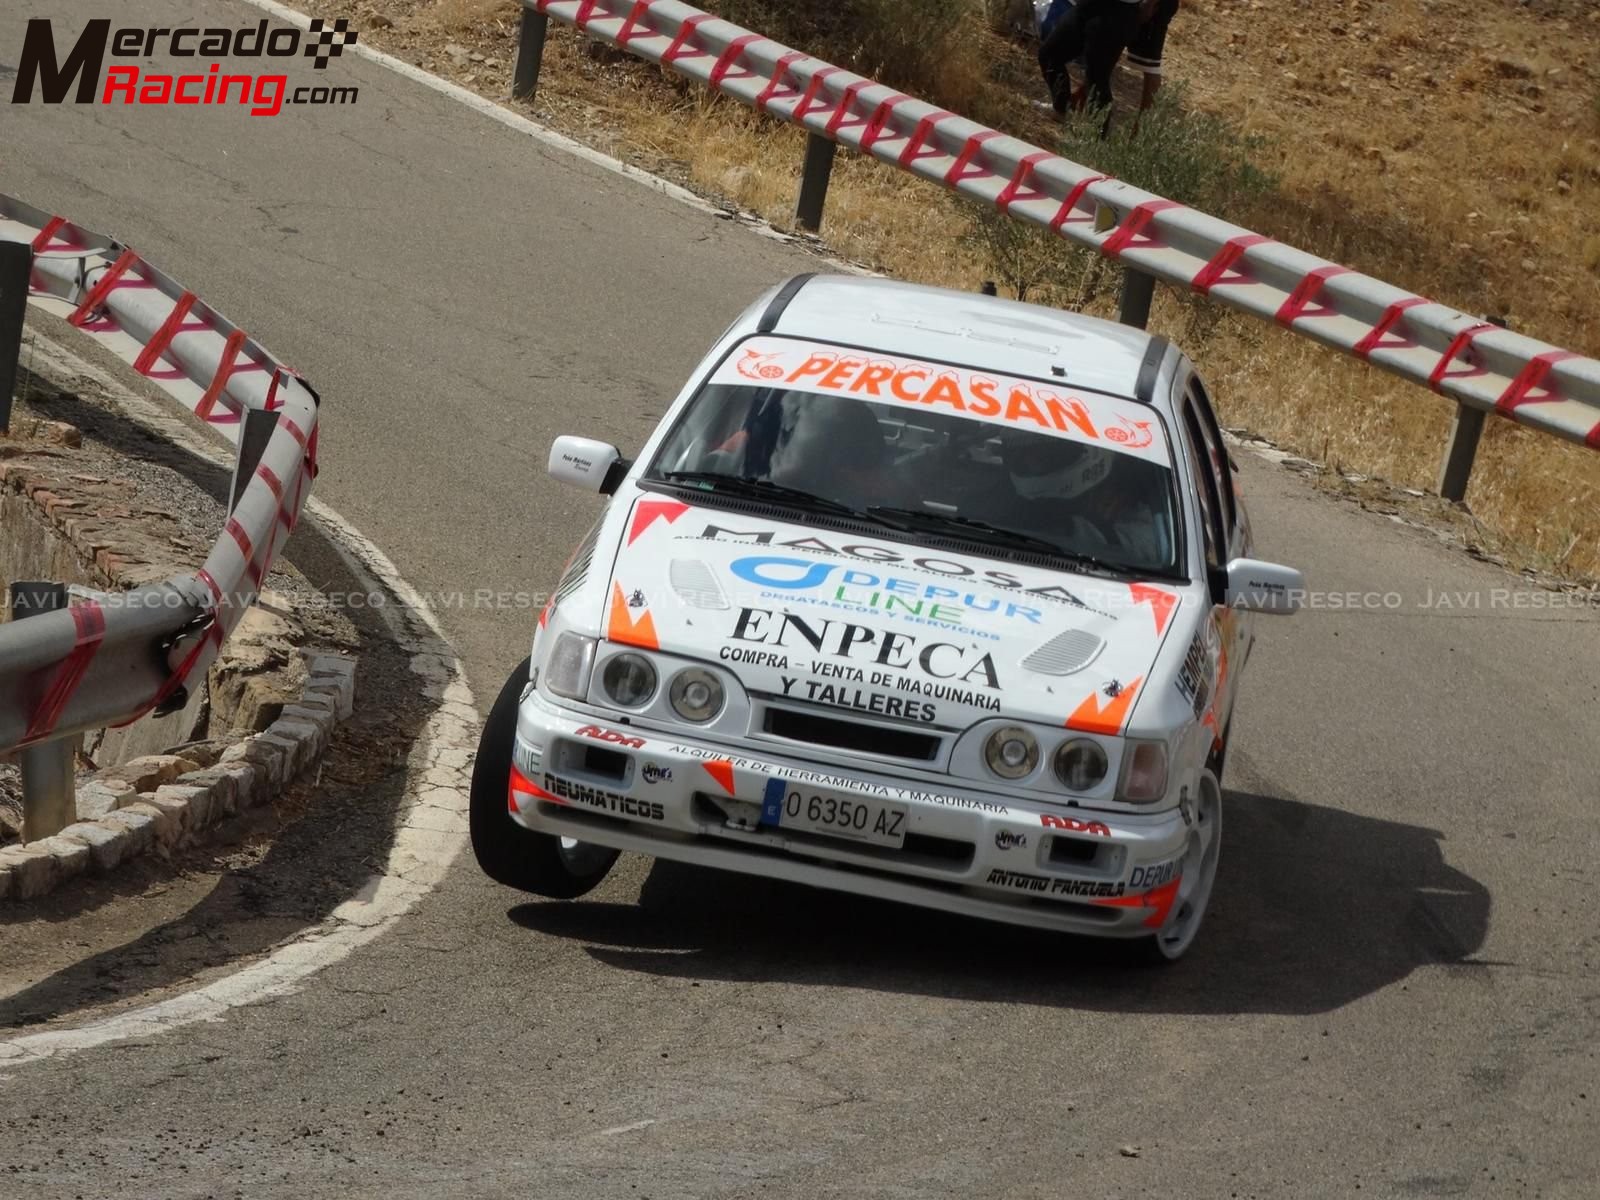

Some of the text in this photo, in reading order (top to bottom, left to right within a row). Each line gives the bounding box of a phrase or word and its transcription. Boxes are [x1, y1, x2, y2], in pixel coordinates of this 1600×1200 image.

[785, 352, 1099, 440] PERCASAN
[673, 535, 728, 543] ACERO
[701, 524, 1086, 606] MAGOSA
[760, 591, 879, 617] DESATASCOS
[884, 611, 898, 619] Y
[904, 615, 1001, 641] SERVICIOS
[835, 585, 966, 625] LINE
[842, 569, 1043, 625] DEPUR
[726, 607, 1003, 690] ENPECA
[720, 645, 788, 669] COMPRA
[812, 660, 864, 683] VENTA
[870, 672, 892, 688] DE
[897, 676, 1001, 712] MAQUINARIA
[781, 676, 937, 722] Y TALLERES
[574, 724, 647, 749] ADA
[668, 745, 1009, 815] ALQUILER DE HERRAMIENTA Y MAQUINARIA
[767, 805, 777, 816] E
[807, 795, 868, 830] 6350
[873, 808, 905, 838] AZ
[1040, 814, 1112, 838] ADA
[986, 868, 1050, 892] ANTONIO
[1130, 861, 1174, 888] DEPUR
